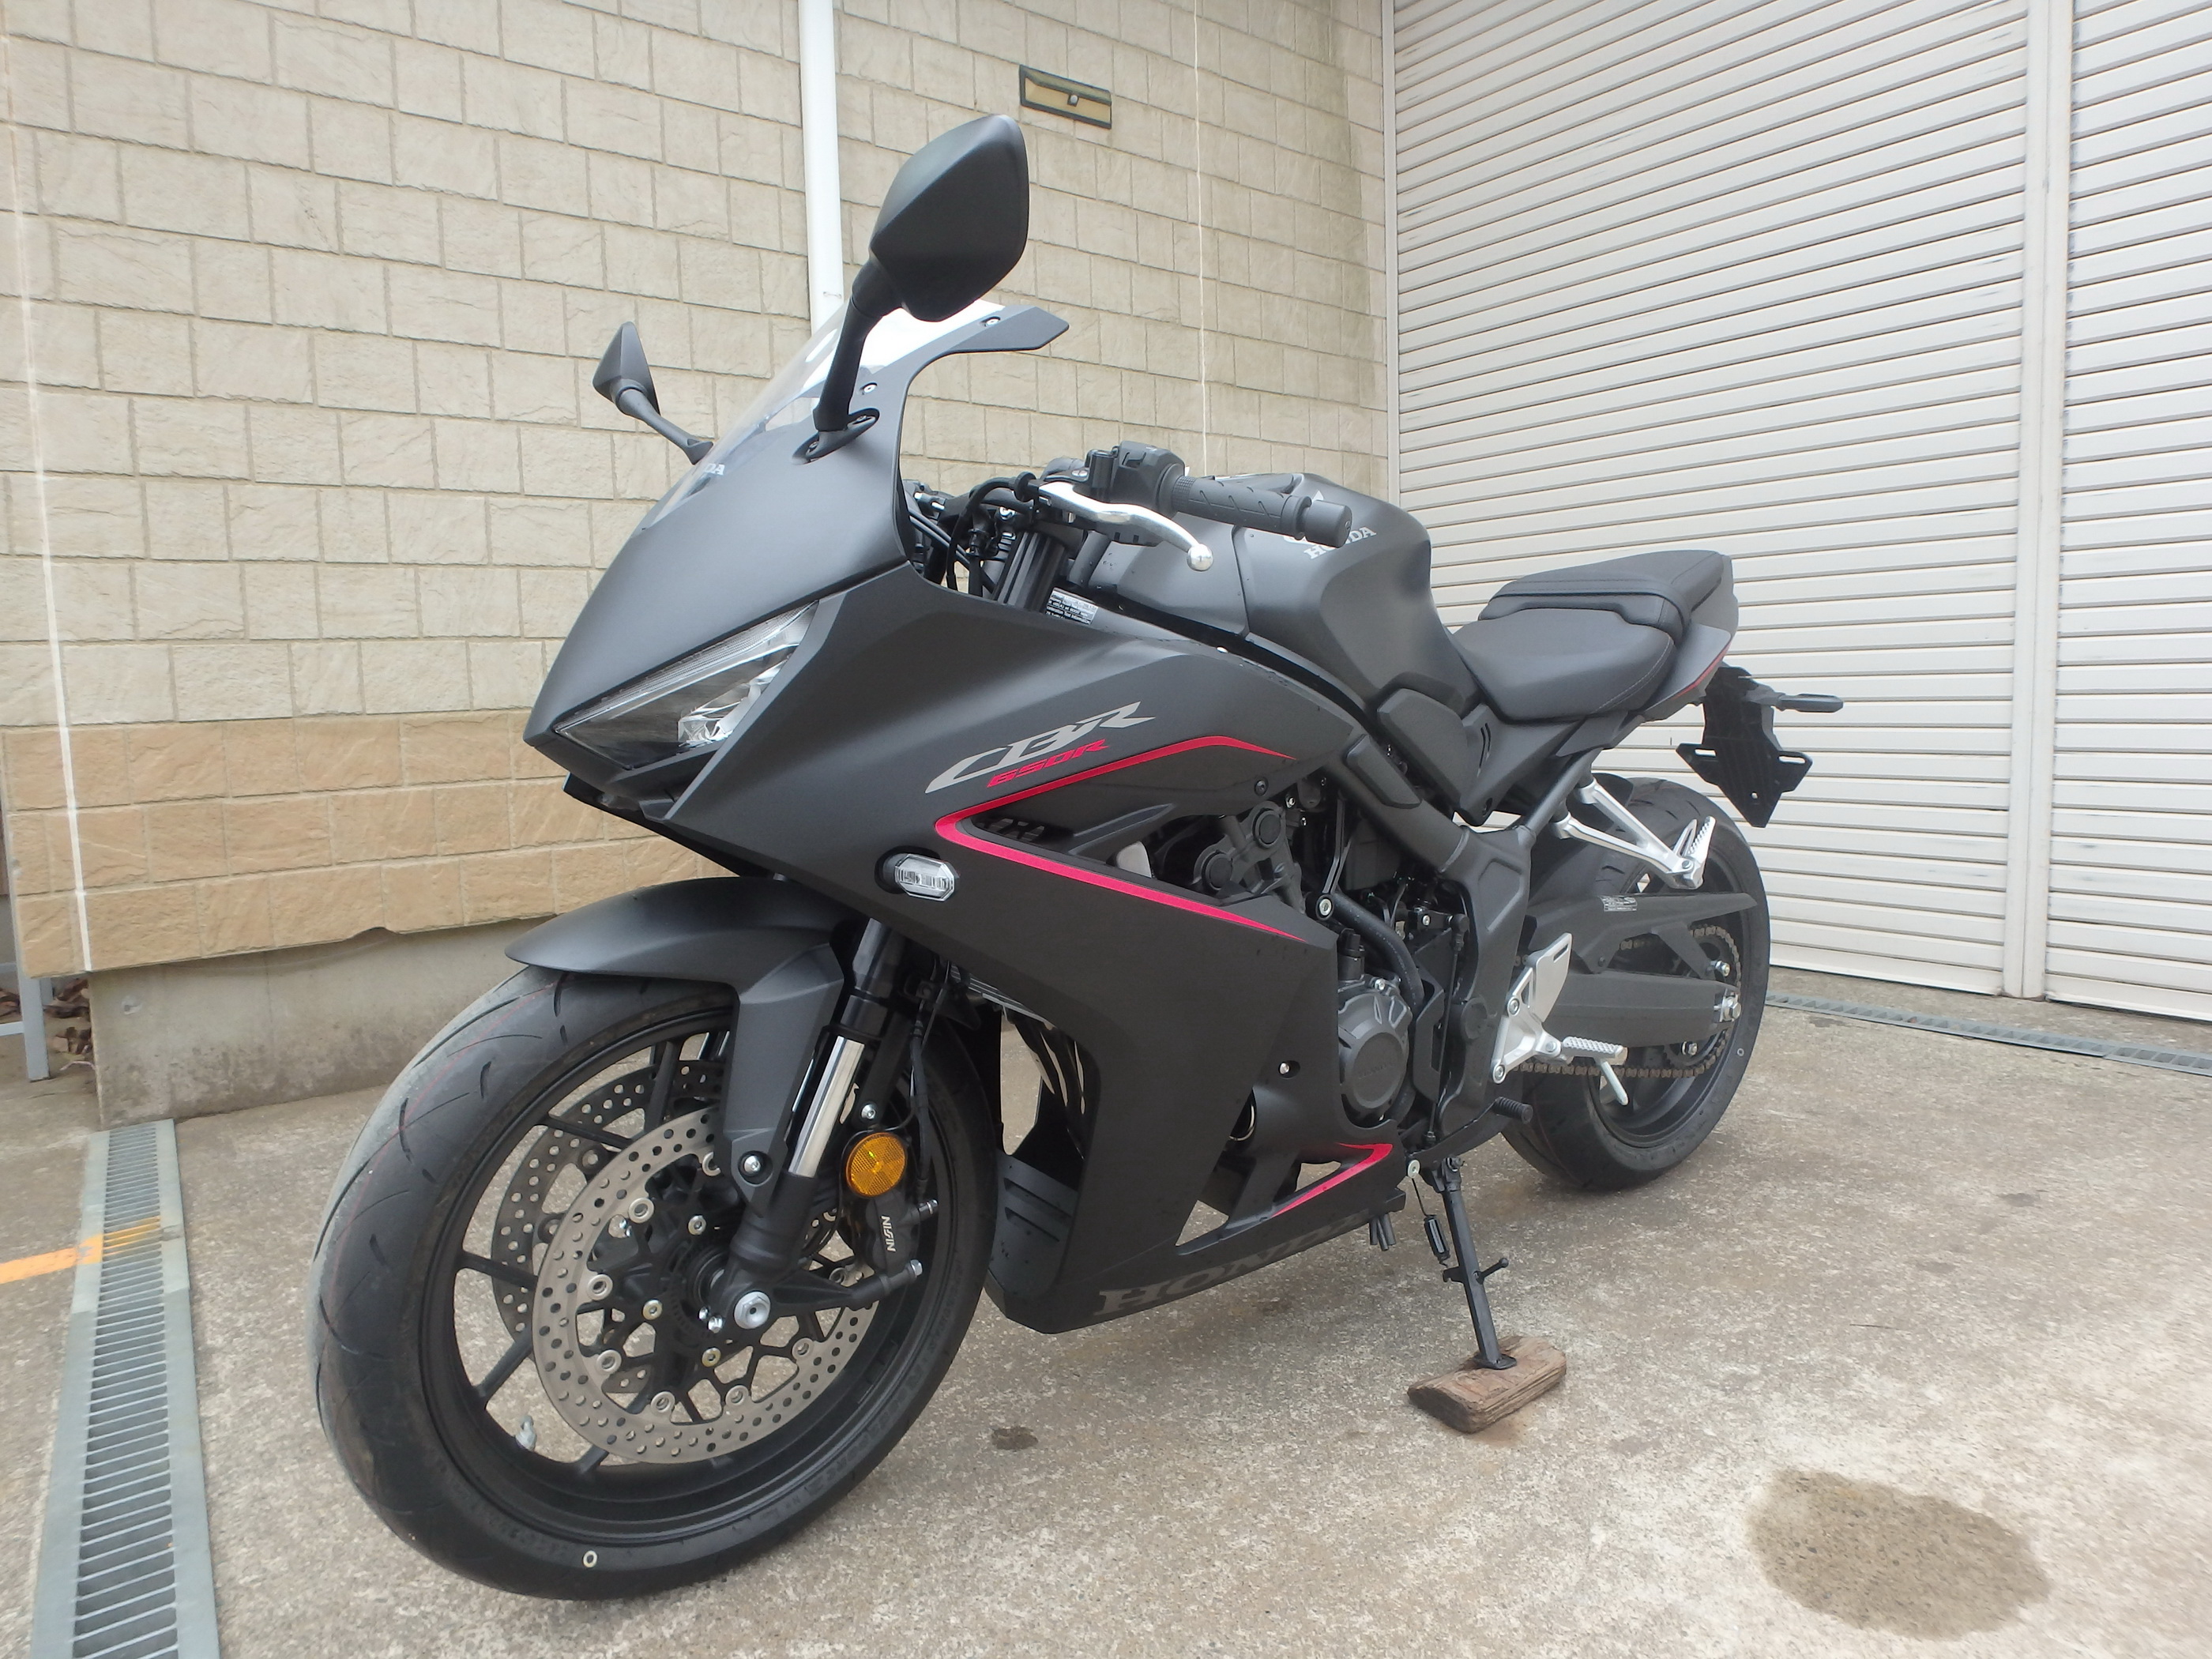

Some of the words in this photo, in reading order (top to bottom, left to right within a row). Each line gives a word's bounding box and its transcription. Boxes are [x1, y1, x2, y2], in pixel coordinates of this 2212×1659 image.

[1304, 527, 1377, 560] HDA
[925, 701, 1156, 794] CBR
[987, 739, 1109, 788] 650R
[881, 1215, 897, 1251] NISSIN
